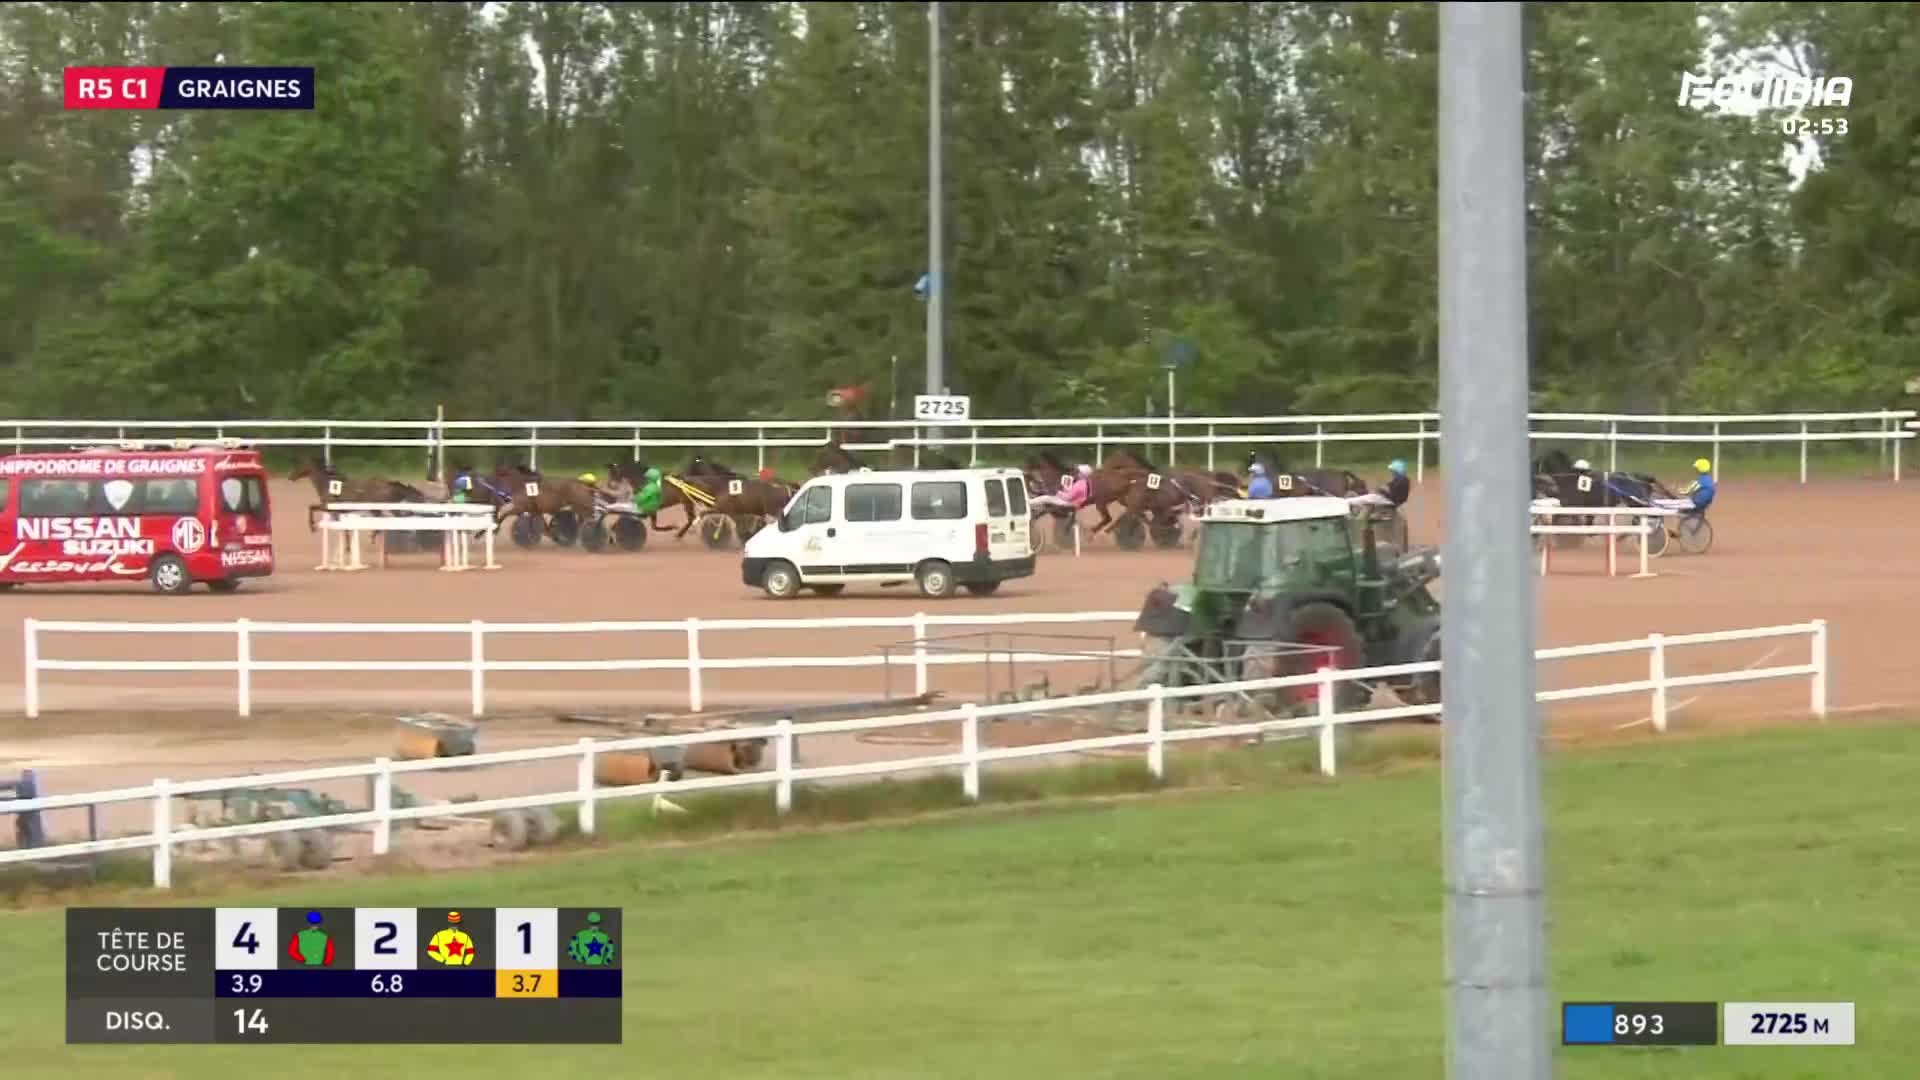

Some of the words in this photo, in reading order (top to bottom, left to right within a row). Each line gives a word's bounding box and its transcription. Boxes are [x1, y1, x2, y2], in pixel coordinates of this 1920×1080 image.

[919, 401, 965, 415] 2725
[0, 459, 101, 475] HIPPODROME
[104, 459, 126, 475] DE
[128, 458, 206, 473] GRAIGNES
[17, 517, 141, 539] NISSAN
[172, 516, 205, 553] MG
[63, 539, 154, 555] SUZUKI
[221, 549, 270, 566] NISSAN
